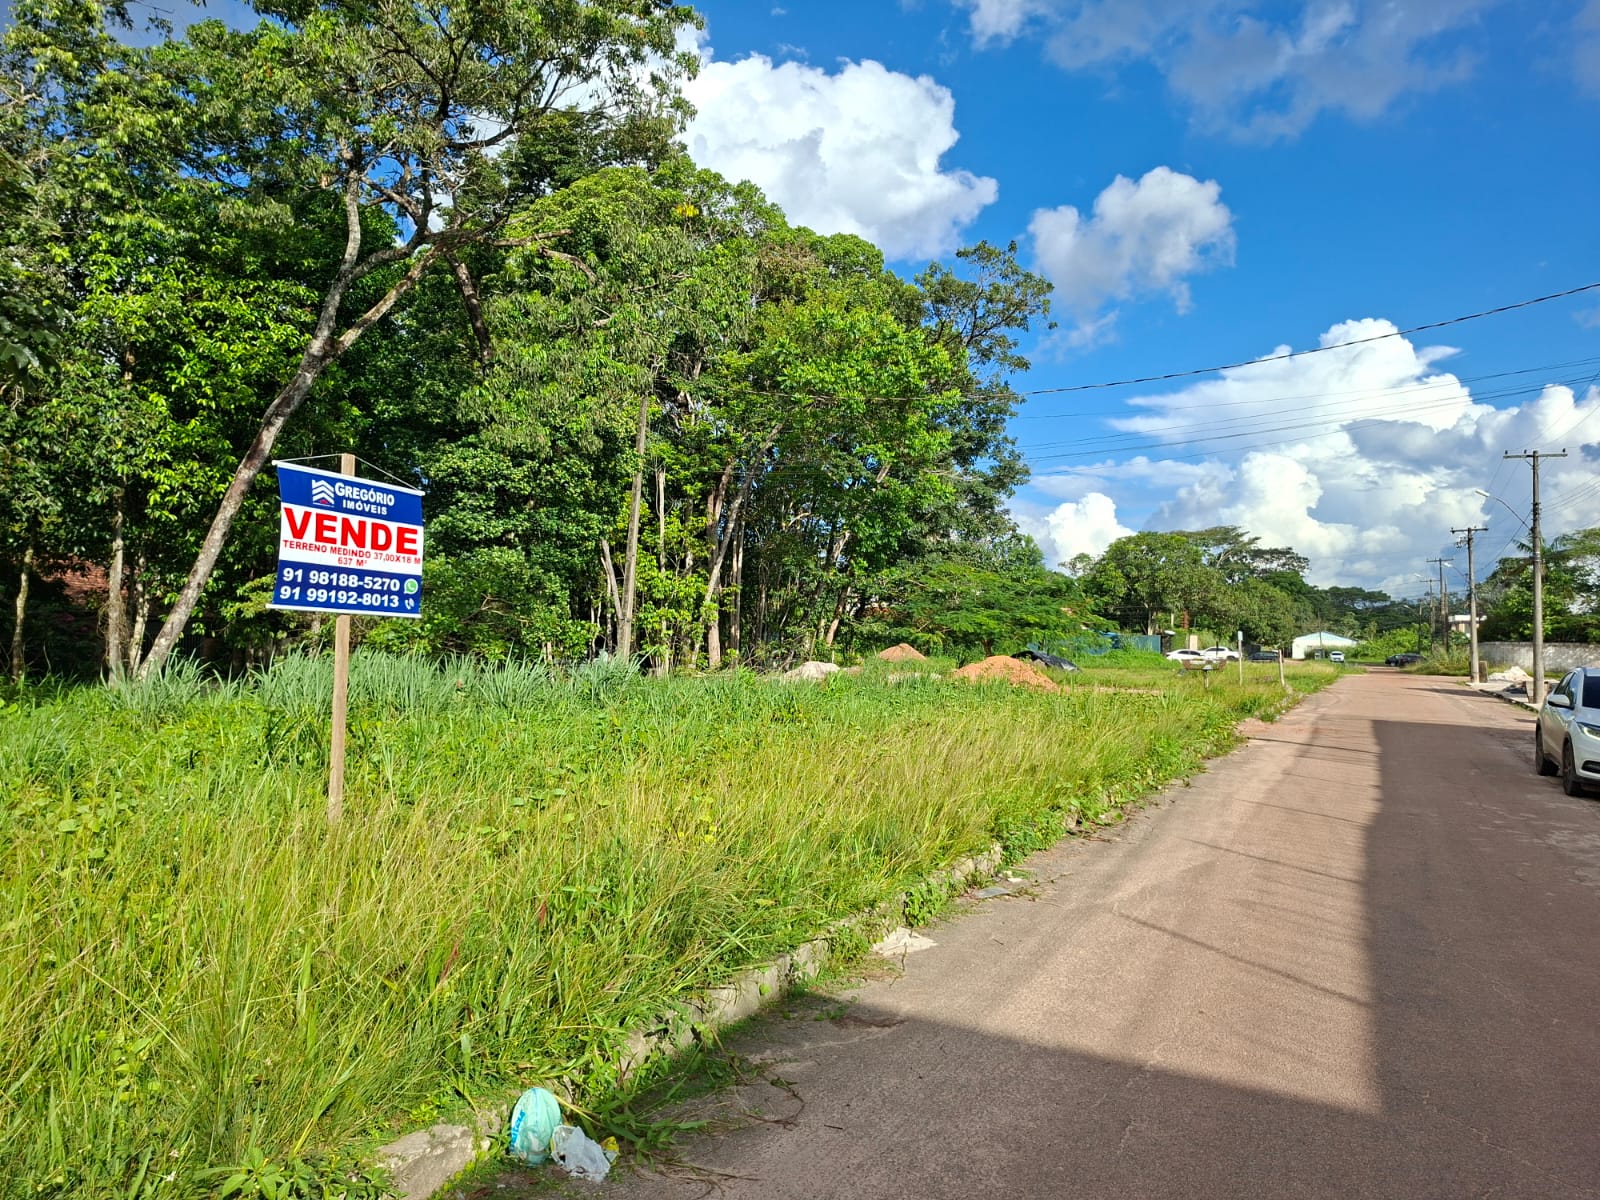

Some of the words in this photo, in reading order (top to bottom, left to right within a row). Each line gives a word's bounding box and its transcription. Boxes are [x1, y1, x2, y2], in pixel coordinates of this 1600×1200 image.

[334, 482, 395, 506] GREGÓRIO
[343, 499, 388, 516] IMÓVEIS
[283, 507, 418, 555] VENDE
[282, 539, 328, 553] TERRENO
[329, 545, 371, 559] MEDINDO
[337, 556, 353, 565] 637
[282, 567, 303, 582] 91
[309, 570, 400, 591] 98188-5270
[279, 585, 301, 600] 91
[306, 588, 400, 608] 99192-8013
